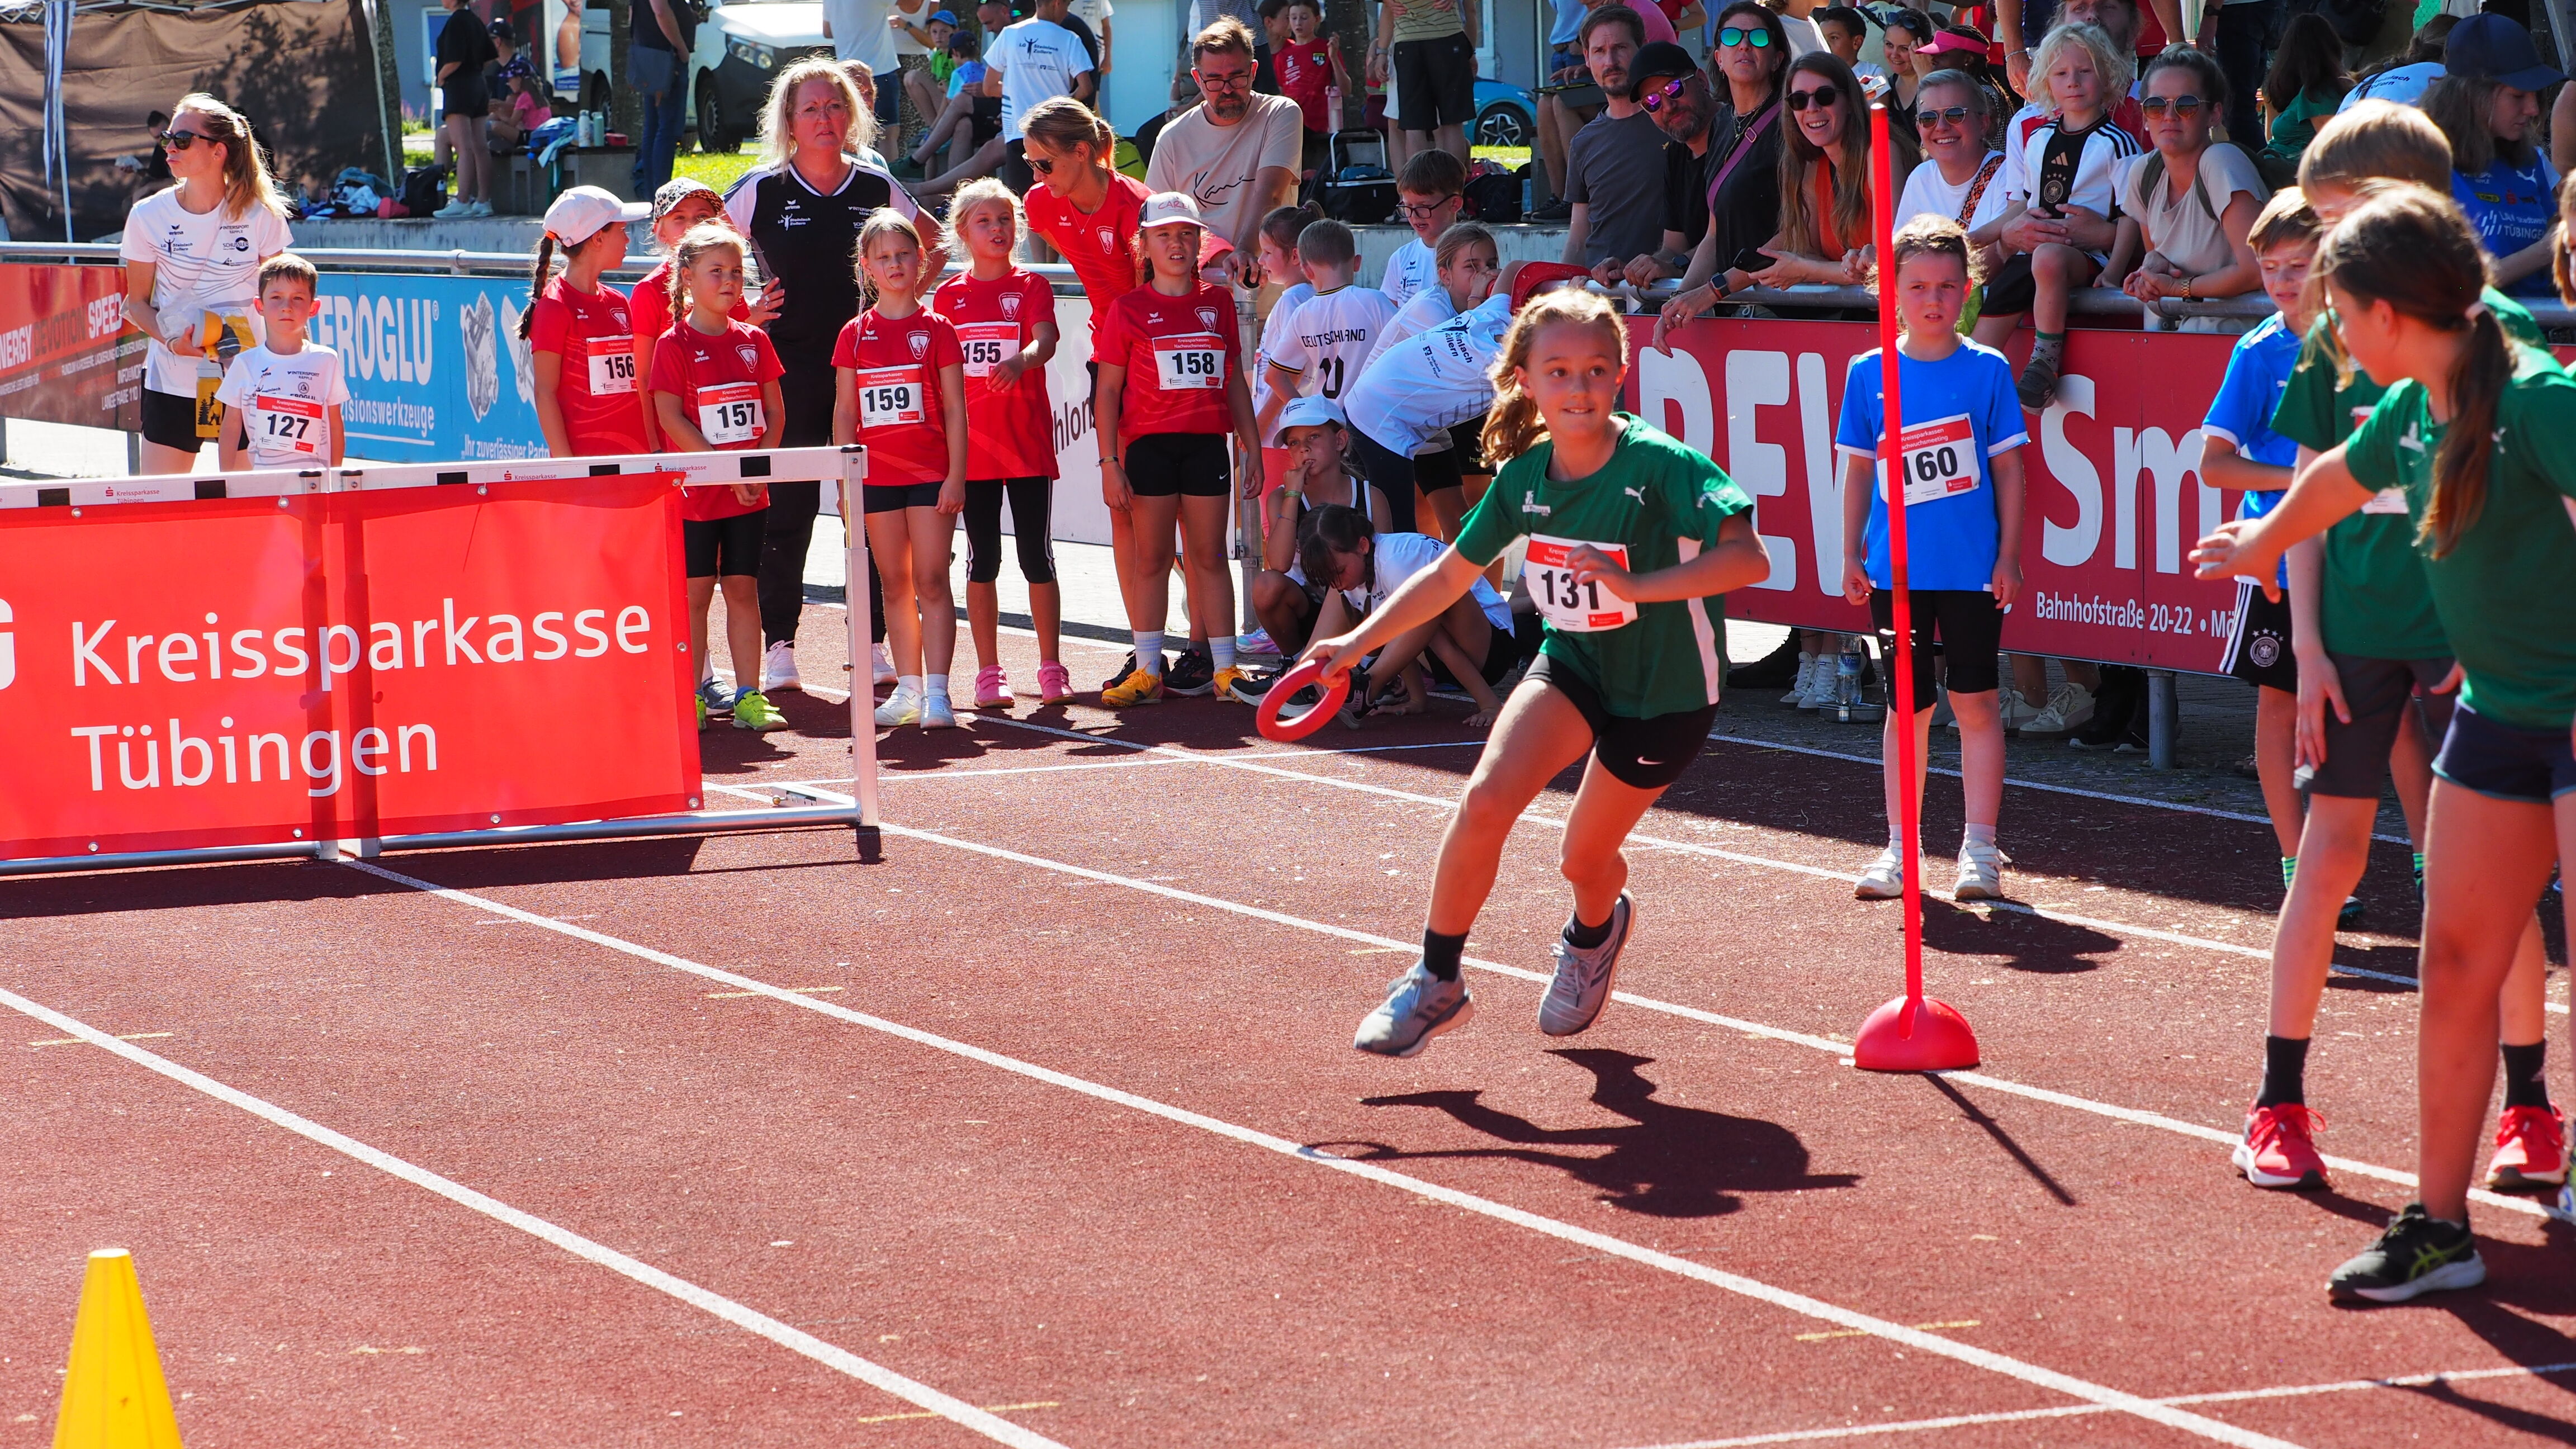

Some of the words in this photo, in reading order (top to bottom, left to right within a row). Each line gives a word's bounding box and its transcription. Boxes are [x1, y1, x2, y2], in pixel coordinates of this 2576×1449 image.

[2503, 224, 2542, 239] TÜBINGE
[88, 292, 123, 339] SPEED
[963, 342, 1001, 364] 155
[1172, 353, 1215, 375] 158
[605, 356, 634, 379] 156
[866, 377, 906, 386] Nachwuchsmeeting
[865, 386, 910, 413] 159
[267, 414, 310, 440] 127
[717, 402, 755, 429] 157
[1901, 428, 1944, 442] Kreissparkassen
[1903, 446, 1958, 486] 160
[1541, 570, 1600, 610] 131
[2037, 591, 2144, 629] Bahnhofstraße
[2149, 603, 2192, 635] 20-22
[72, 598, 651, 692] Kreissparkasse
[71, 716, 437, 798] Tübingen
